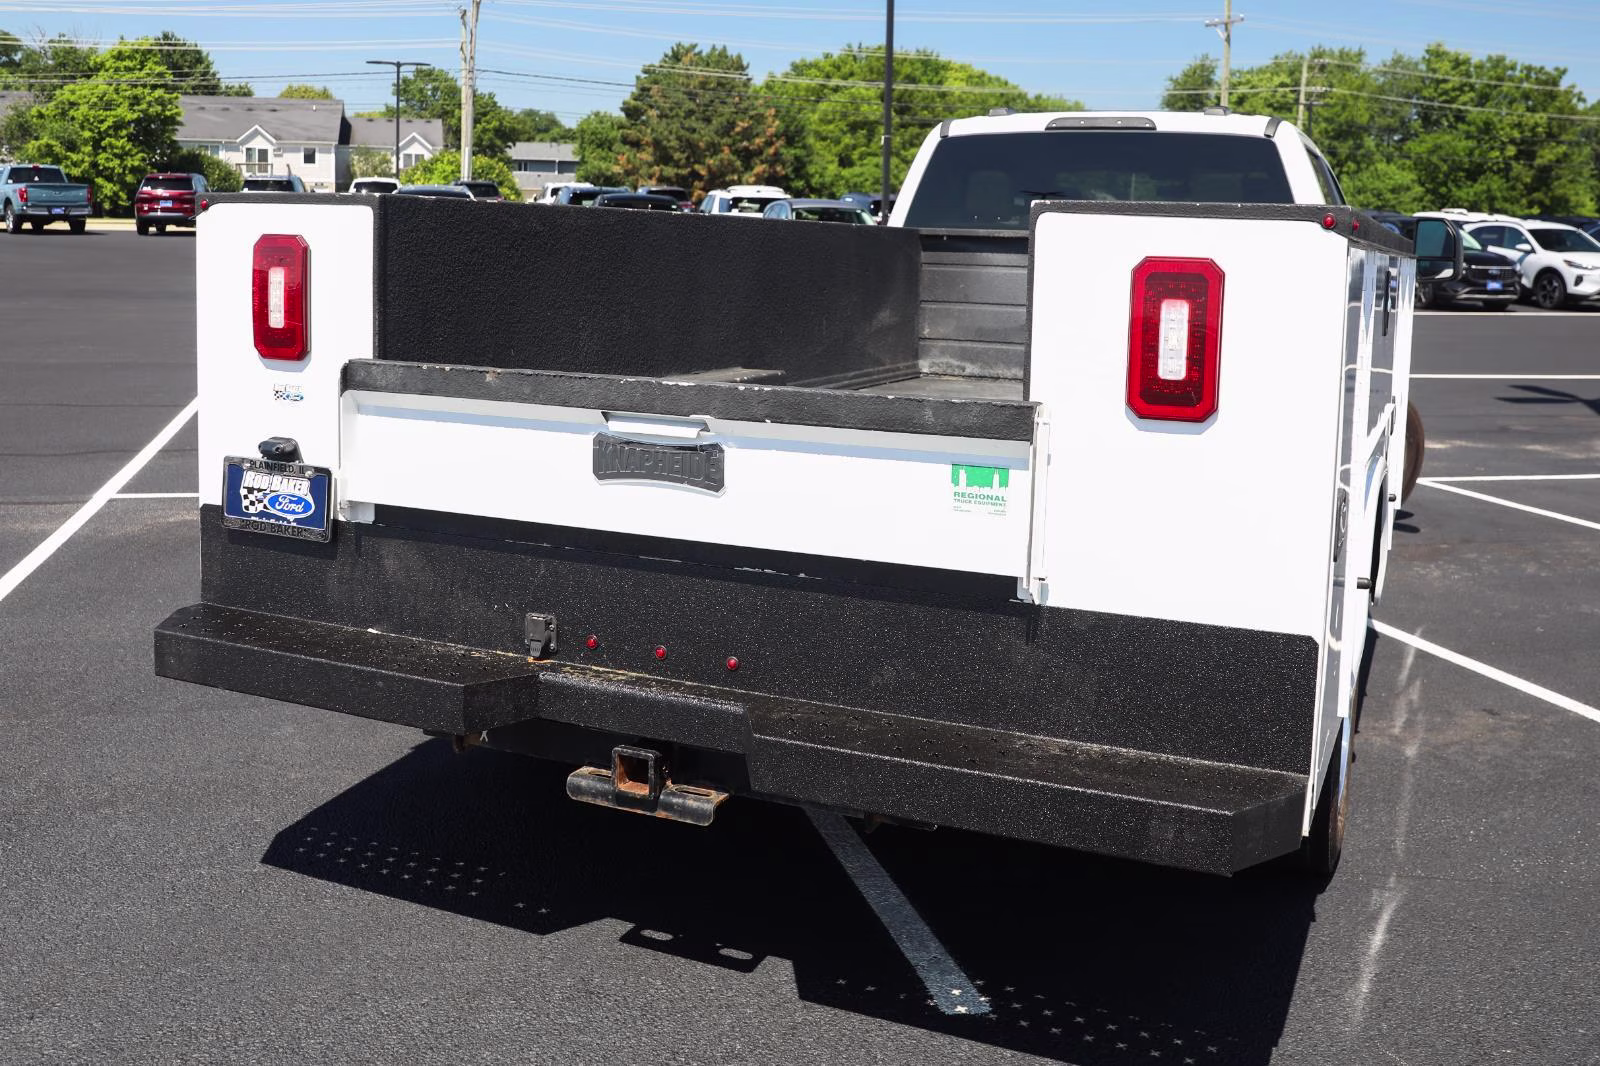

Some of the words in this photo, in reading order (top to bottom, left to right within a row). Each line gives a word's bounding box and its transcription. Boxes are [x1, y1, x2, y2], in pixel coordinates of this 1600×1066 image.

[243, 471, 270, 491] ROD
[270, 473, 310, 496] BAKER
[275, 495, 305, 513] Ford
[953, 491, 1007, 502] REGIONAL
[245, 520, 267, 532] ROD
[270, 524, 304, 538] BAKER
